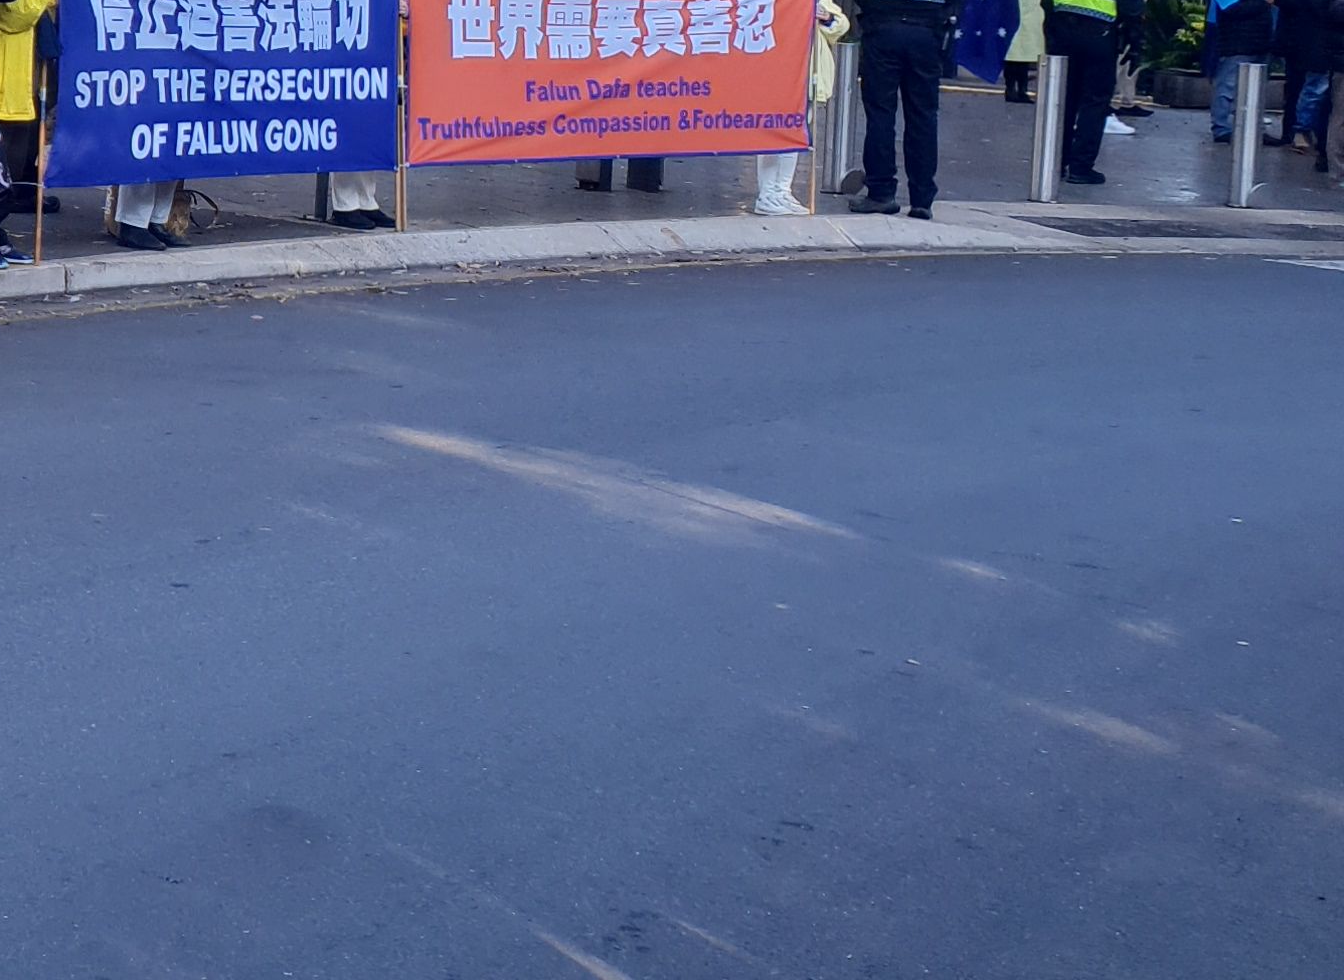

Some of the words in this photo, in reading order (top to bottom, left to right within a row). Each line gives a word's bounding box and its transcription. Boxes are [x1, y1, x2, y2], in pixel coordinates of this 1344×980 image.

[74, 70, 145, 108] STOP
[153, 68, 206, 102] THE
[214, 67, 388, 101] PERSECUTION
[525, 79, 581, 102] Falun
[586, 78, 630, 100] Dafa
[637, 76, 711, 98] teaches
[131, 123, 168, 159] OF
[175, 120, 258, 156] FALUN
[264, 118, 337, 152] GONG
[417, 116, 547, 141] Truthfulness
[552, 111, 670, 138] Compassion
[678, 109, 805, 131] &Forbearance
